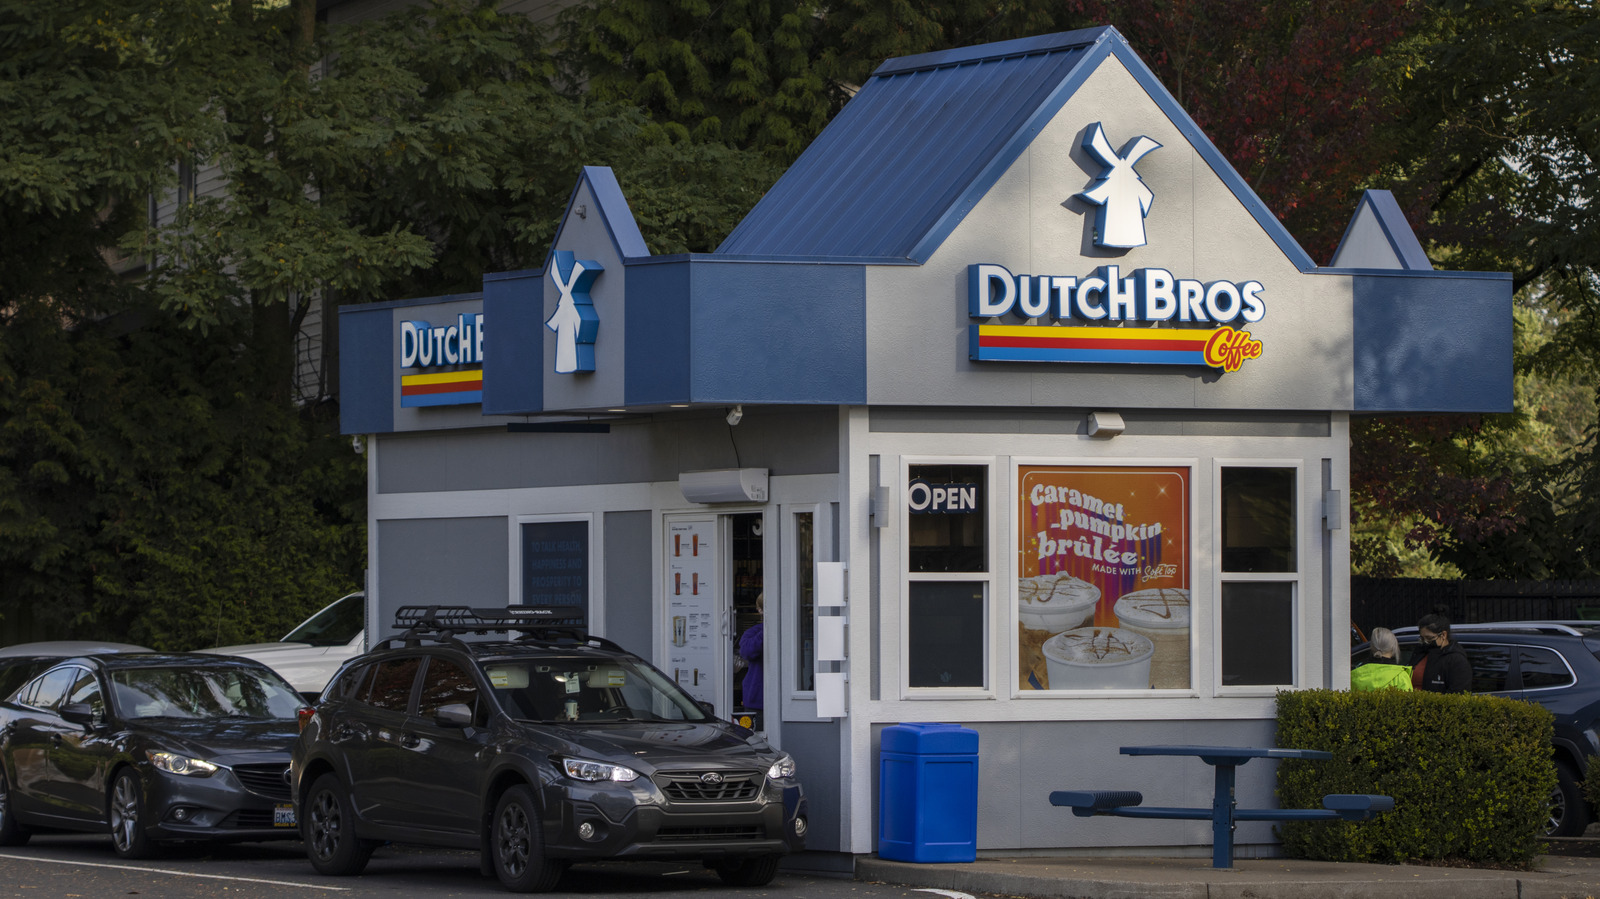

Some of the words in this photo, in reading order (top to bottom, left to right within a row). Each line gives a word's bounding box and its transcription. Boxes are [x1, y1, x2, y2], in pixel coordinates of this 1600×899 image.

[974, 263, 1138, 320] DUTCH
[1142, 267, 1266, 323] BROS
[400, 313, 472, 368] DUTCH
[1203, 326, 1262, 372] Coffee
[909, 482, 976, 511] OPEN
[1051, 509, 1162, 543] pumpkin
[1092, 563, 1117, 575] MADE
[1119, 567, 1142, 576] WITH
[276, 812, 296, 823] BMS3
